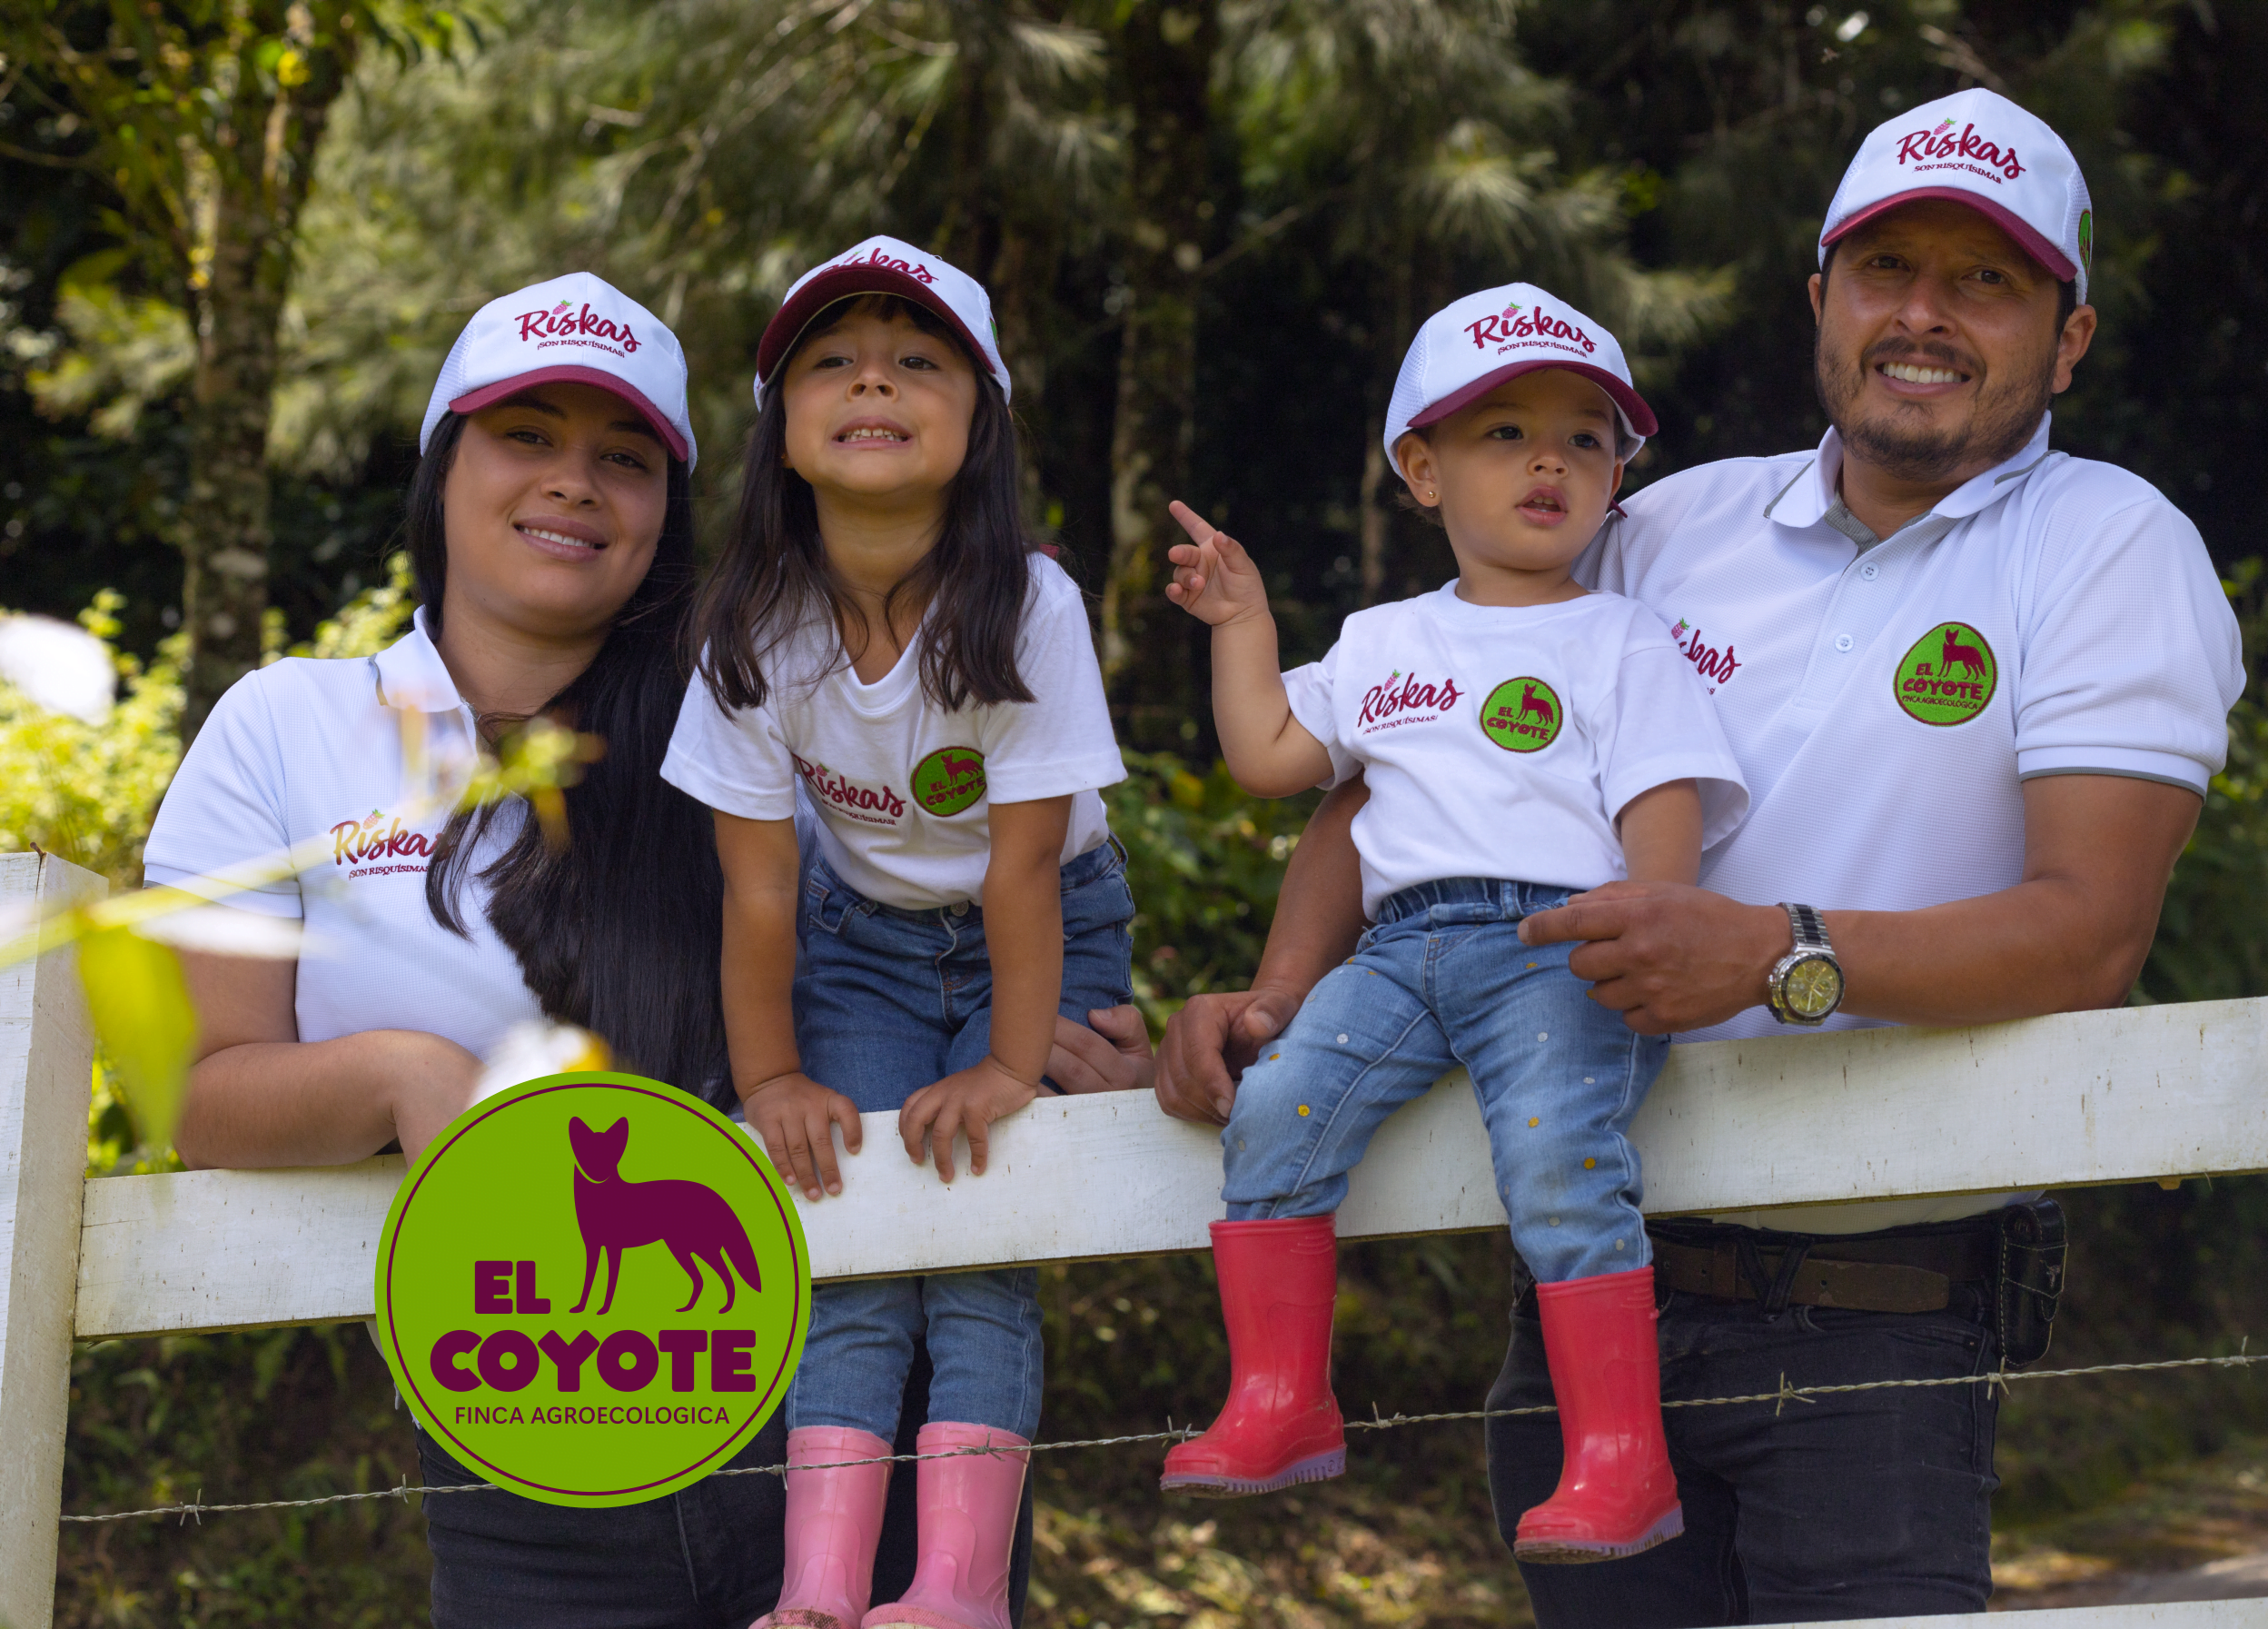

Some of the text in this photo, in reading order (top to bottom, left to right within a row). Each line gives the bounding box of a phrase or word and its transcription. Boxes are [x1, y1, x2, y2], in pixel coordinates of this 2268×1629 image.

[1896, 124, 2026, 179] Riskas
[514, 303, 642, 353] Riskas
[1463, 306, 1598, 353] Riskas
[1916, 662, 1934, 676] EL
[1357, 672, 1465, 728] Riskas
[1903, 678, 1984, 700] COYOTE
[1498, 706, 1514, 719] EL
[1487, 717, 1550, 740] COYOTE
[789, 751, 906, 818] Riskas
[926, 776, 985, 806] COYOTE
[929, 781, 946, 792] EL
